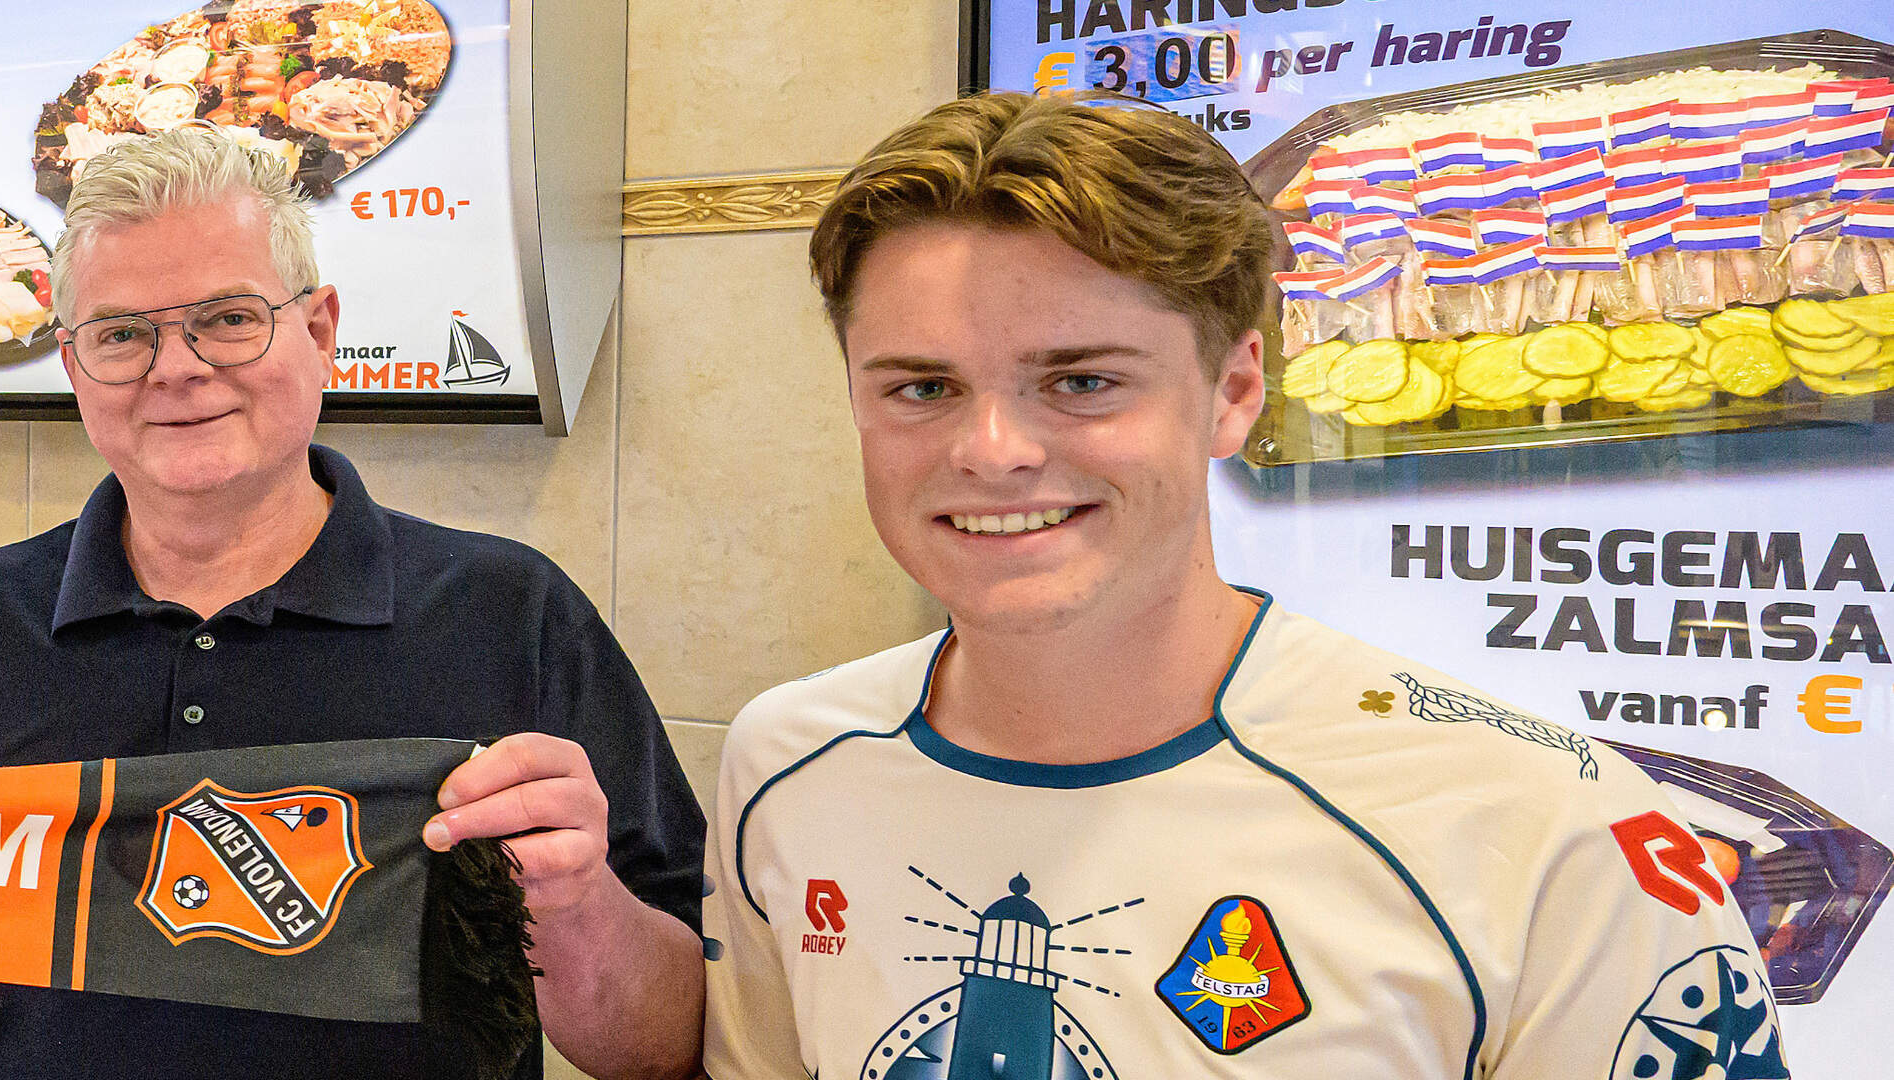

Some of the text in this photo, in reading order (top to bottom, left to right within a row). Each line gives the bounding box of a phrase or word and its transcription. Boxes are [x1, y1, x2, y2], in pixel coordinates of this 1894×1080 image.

[1093, 33, 1236, 97] 3,00
[1255, 41, 1354, 93] per
[1371, 17, 1571, 68] haring
[350, 186, 471, 221] € 170,-
[335, 344, 396, 360] enaar
[323, 361, 441, 390] MMER
[1389, 523, 1894, 595] HUISGEMA
[1578, 674, 1864, 735] vanaf €
[177, 797, 318, 941] FC VOLENDAM
[800, 934, 847, 956] ROBEY
[1195, 973, 1267, 997] TELSTAR
